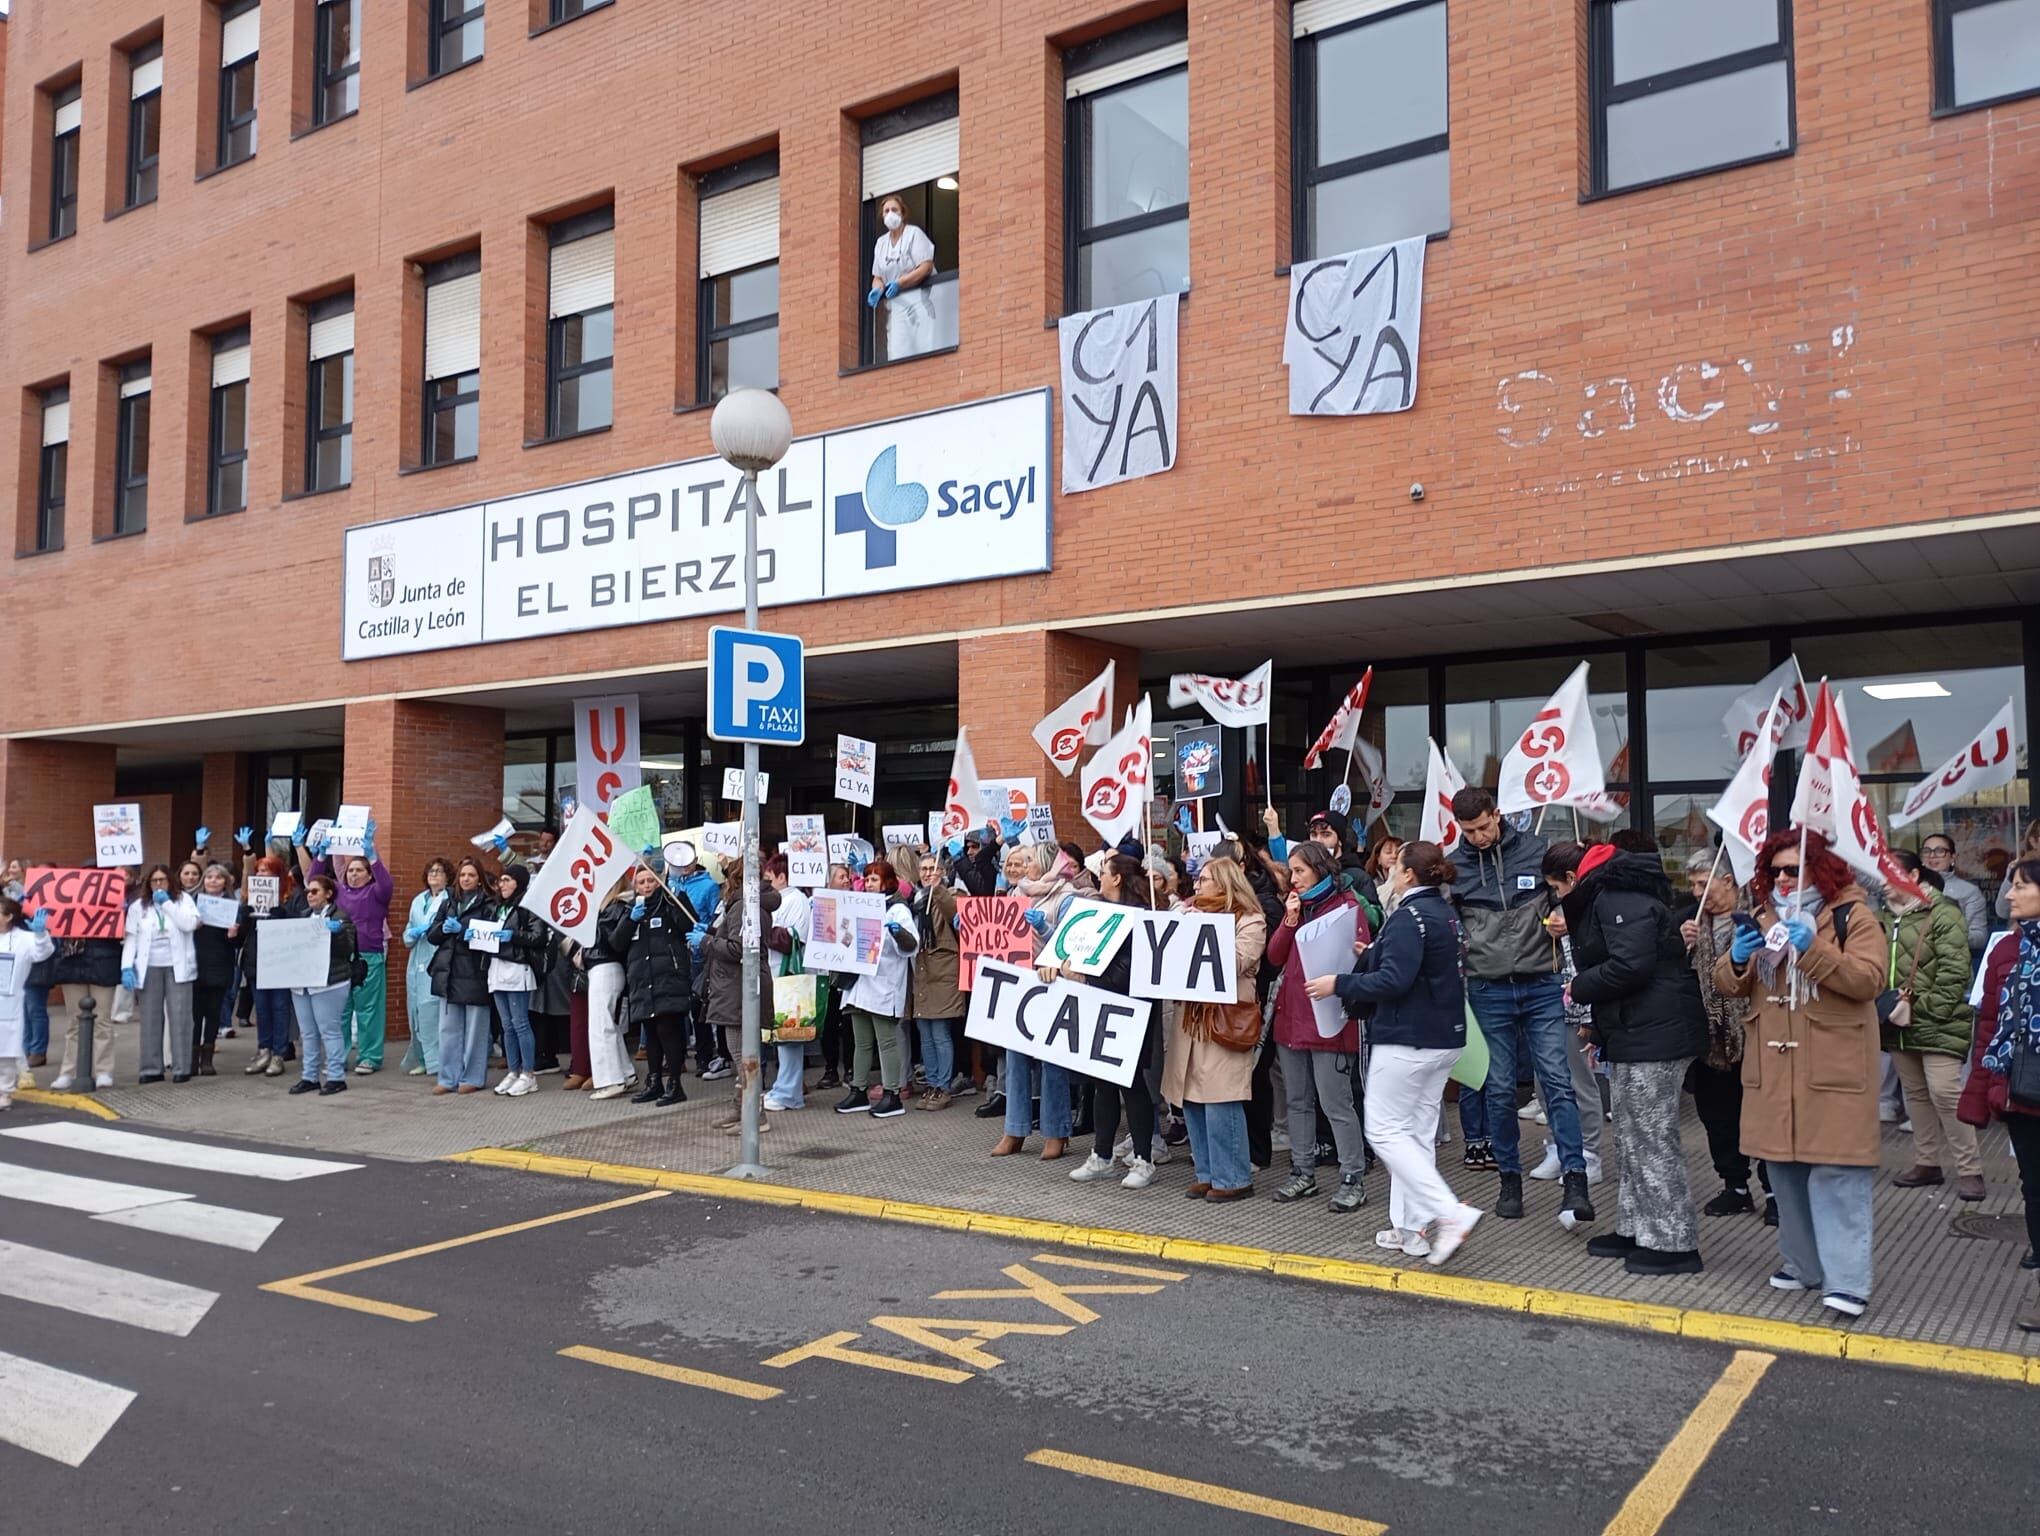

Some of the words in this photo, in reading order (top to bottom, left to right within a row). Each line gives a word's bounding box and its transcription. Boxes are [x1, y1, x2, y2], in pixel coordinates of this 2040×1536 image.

[1295, 246, 1399, 342] C1
[1072, 299, 1158, 384] C1
[1309, 325, 1412, 413] YA
[1072, 379, 1171, 483] YA
[937, 466, 1035, 520] Sacyl
[491, 467, 812, 562] HOSPITAL
[399, 585, 441, 604] Junta
[446, 577, 466, 597] de
[517, 582, 569, 617] EL
[591, 548, 776, 608] BIERZO
[358, 615, 409, 639] Castilla
[413, 616, 424, 638] y
[428, 607, 465, 630] León
[732, 642, 785, 728] P
[758, 705, 799, 725] TAXI
[759, 722, 765, 730] 6
[767, 722, 798, 733] PLAZAS
[839, 777, 853, 791] C1
[856, 781, 870, 796] YA
[1030, 807, 1051, 819] TCAE
[101, 845, 117, 856] C1
[121, 844, 137, 855] YA
[346, 838, 361, 846] YA
[722, 834, 738, 847] YA
[831, 843, 841, 854] C1
[886, 833, 900, 845] C1
[904, 833, 920, 844] YA
[252, 878, 273, 888] TCAE
[792, 862, 805, 874] C1
[809, 862, 823, 875] YA
[80, 908, 122, 937] YA
[960, 898, 1031, 947] DIGNIDAD
[1055, 909, 1125, 966] C1
[1143, 919, 1226, 993] YA
[981, 966, 1135, 1067] TCAE
[760, 1253, 1191, 1384] TAXI
